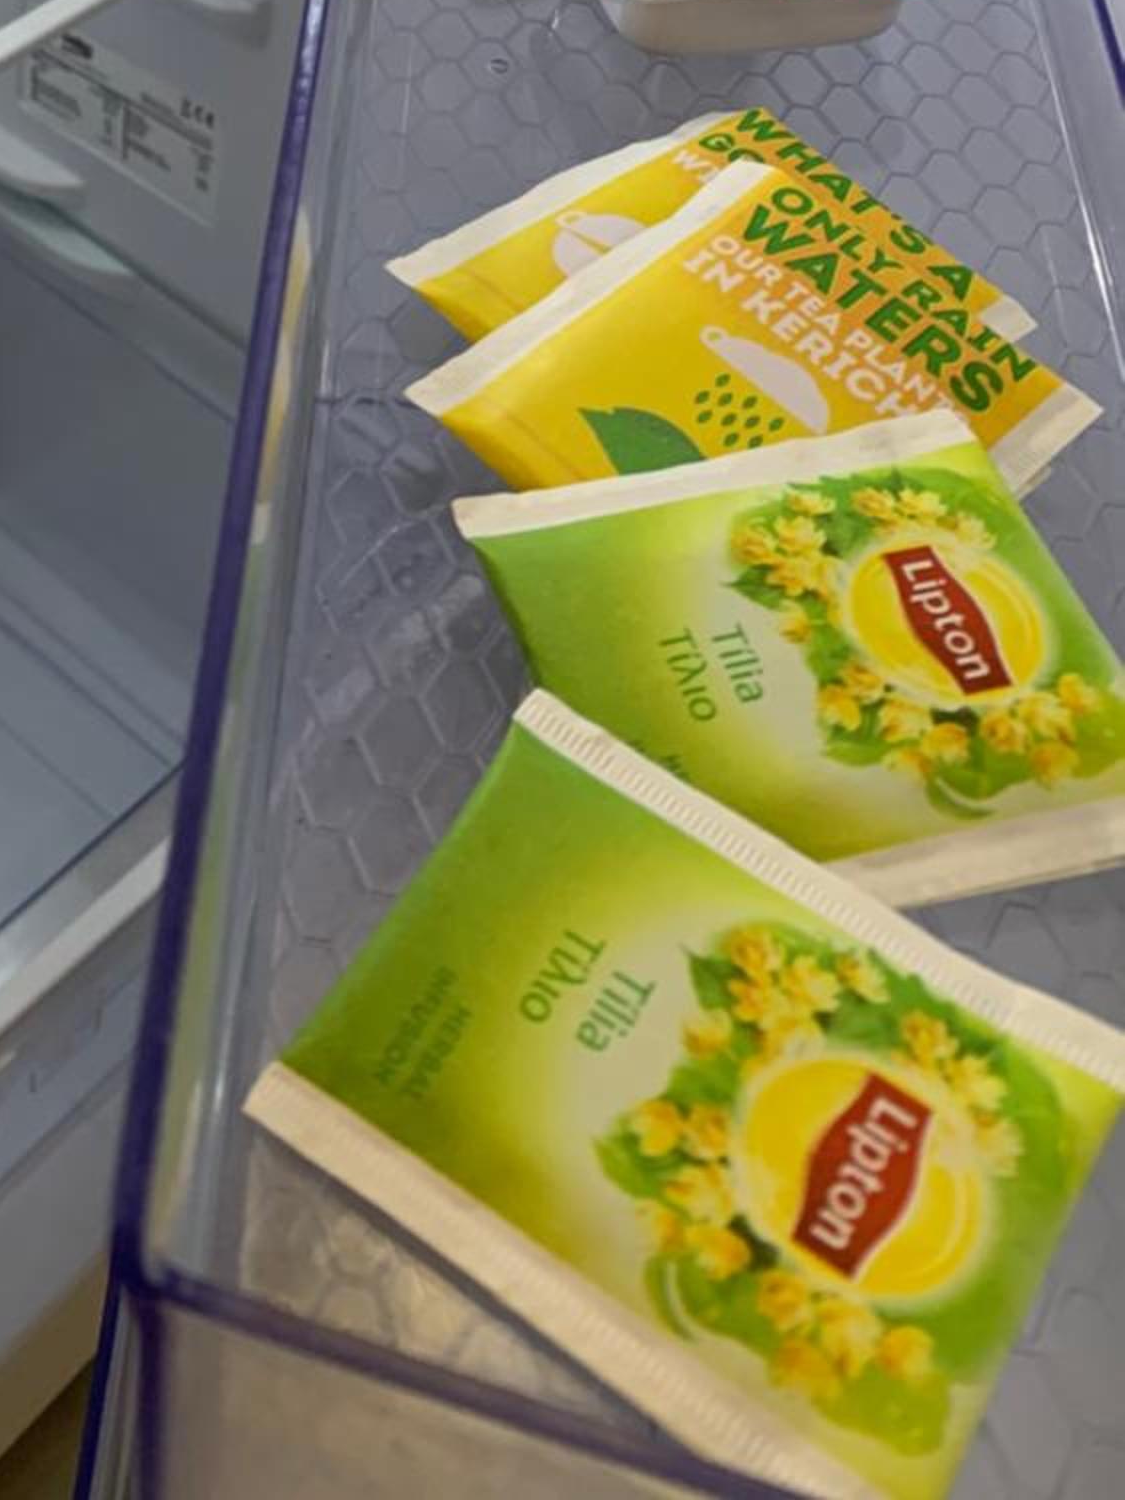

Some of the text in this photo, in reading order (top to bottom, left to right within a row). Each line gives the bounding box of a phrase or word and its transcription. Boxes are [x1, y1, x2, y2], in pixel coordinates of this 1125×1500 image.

[682, 247, 747, 294] IN
[710, 234, 784, 287] OUR
[782, 280, 842, 337] TEA
[743, 203, 1004, 413] WATERS
[771, 187, 1037, 383] ONLY RAIN
[926, 265, 974, 303] A
[711, 621, 764, 704] Tilia
[900, 558, 992, 681] Lipton
[575, 970, 658, 1053] Tilia
[809, 1094, 919, 1250] Lipton
